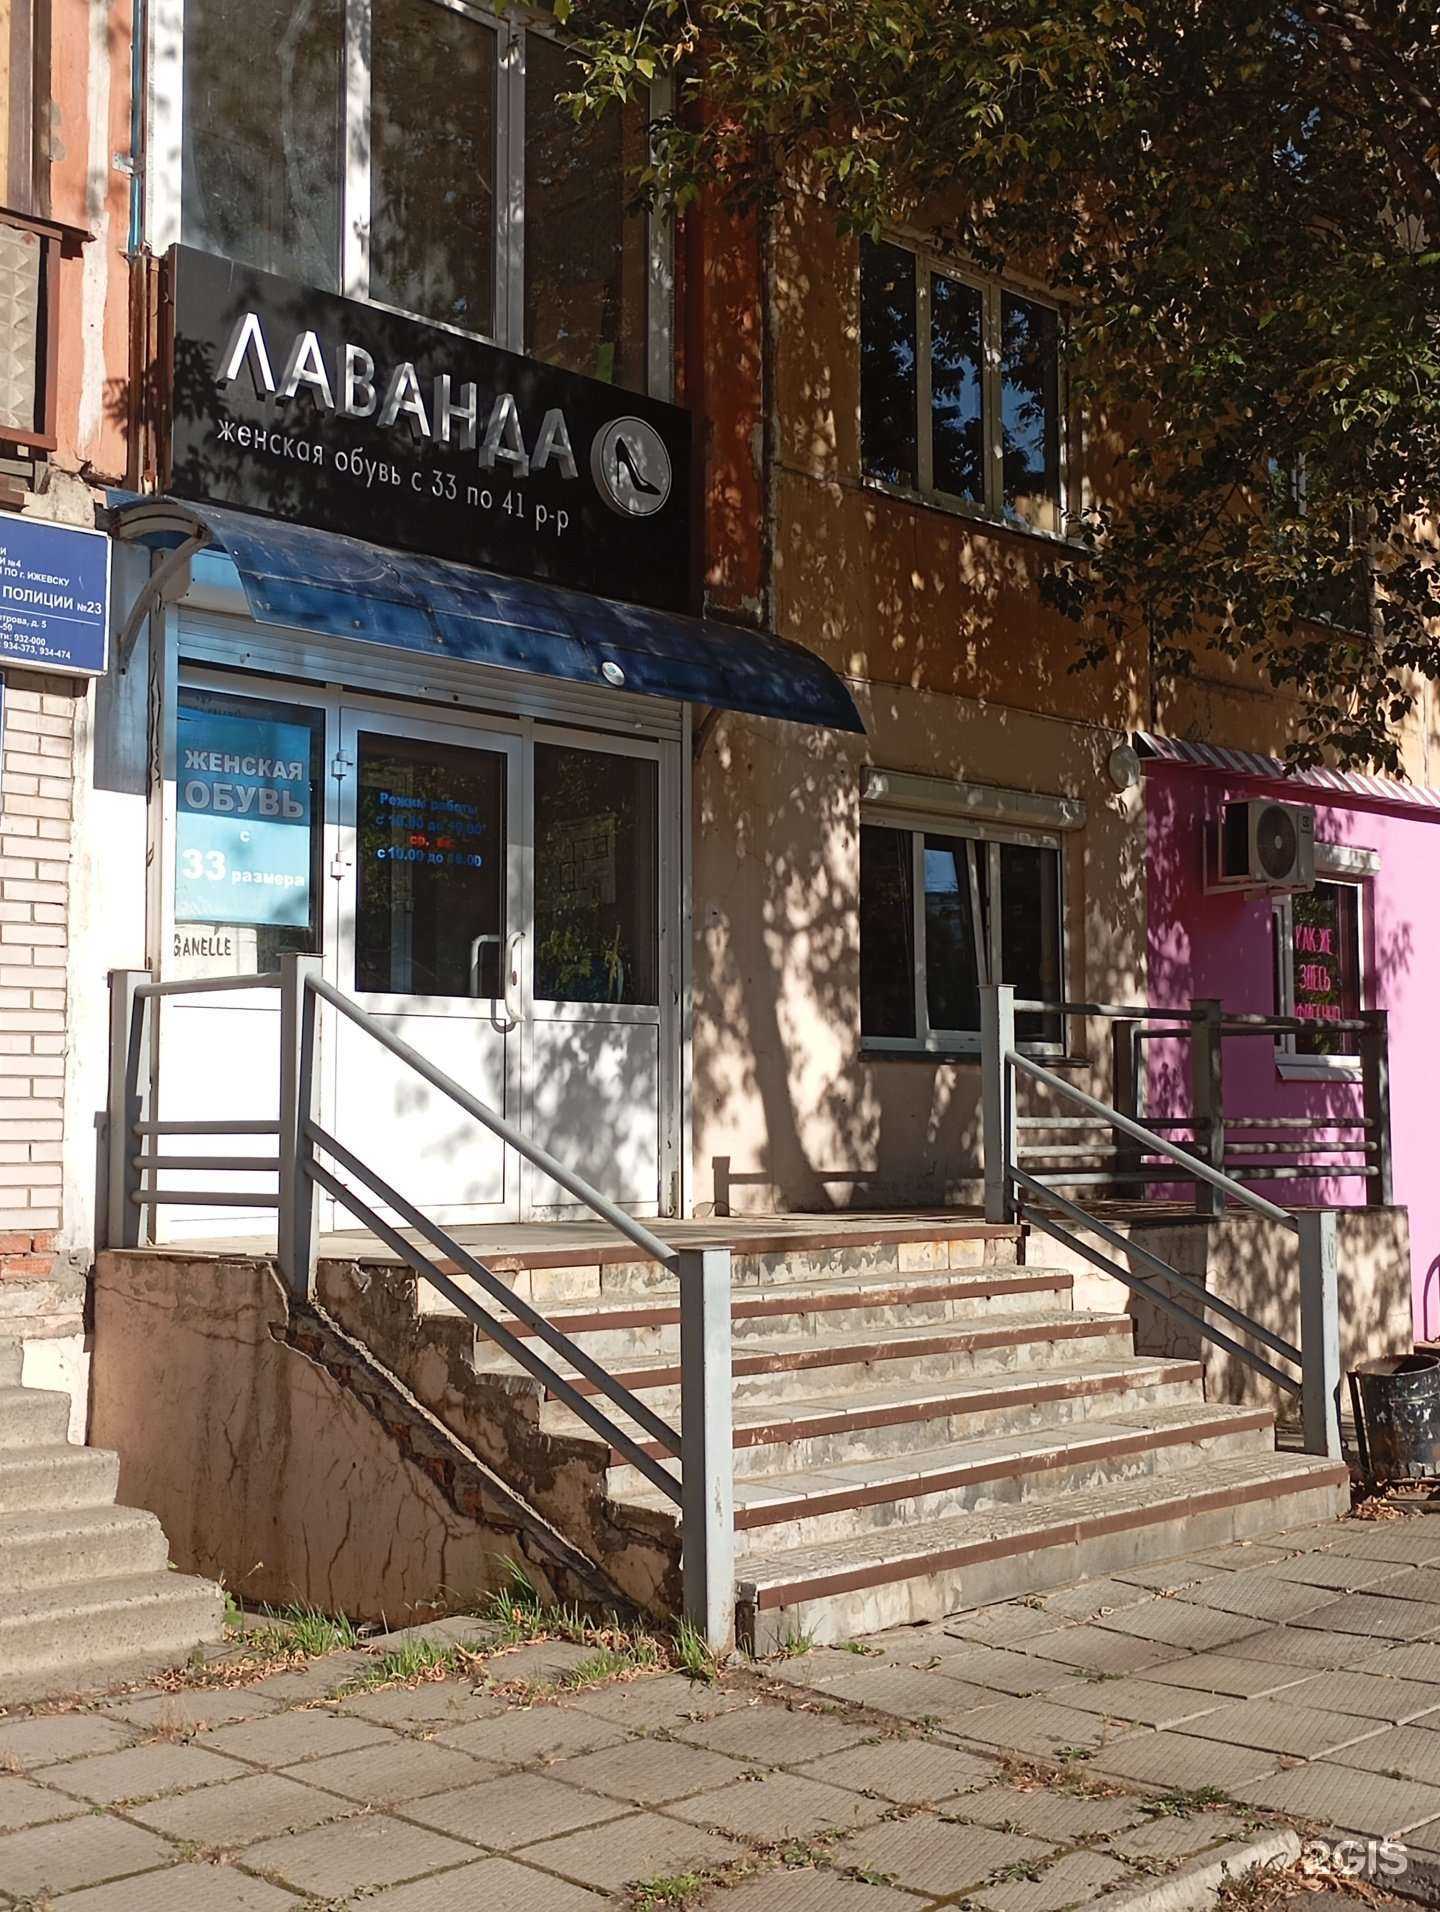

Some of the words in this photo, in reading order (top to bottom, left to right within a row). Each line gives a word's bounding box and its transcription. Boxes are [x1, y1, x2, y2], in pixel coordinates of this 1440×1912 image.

[216, 312, 579, 480] ЛАВАНДА
[216, 417, 324, 466] женская
[334, 448, 402, 489] обувь
[411, 470, 423, 493] с
[431, 469, 458, 501] 33
[467, 488, 494, 510] по
[502, 489, 525, 518] 41
[535, 502, 570, 537] р-р
[4, 567, 18, 577] ПО
[27, 571, 70, 587] ИЖЕВСКУ
[2, 585, 74, 610] ПОЛИЦИИ
[77, 601, 102, 615] №23
[14, 634, 46, 647] 932-000
[39, 646, 71, 660] 934-474
[184, 749, 304, 781] ЖЕНСКАЯ
[184, 780, 304, 819] ОБУВЬ
[239, 830, 250, 843] с
[181, 848, 228, 881] 33
[231, 869, 305, 888] размера
[376, 848, 387, 859] с
